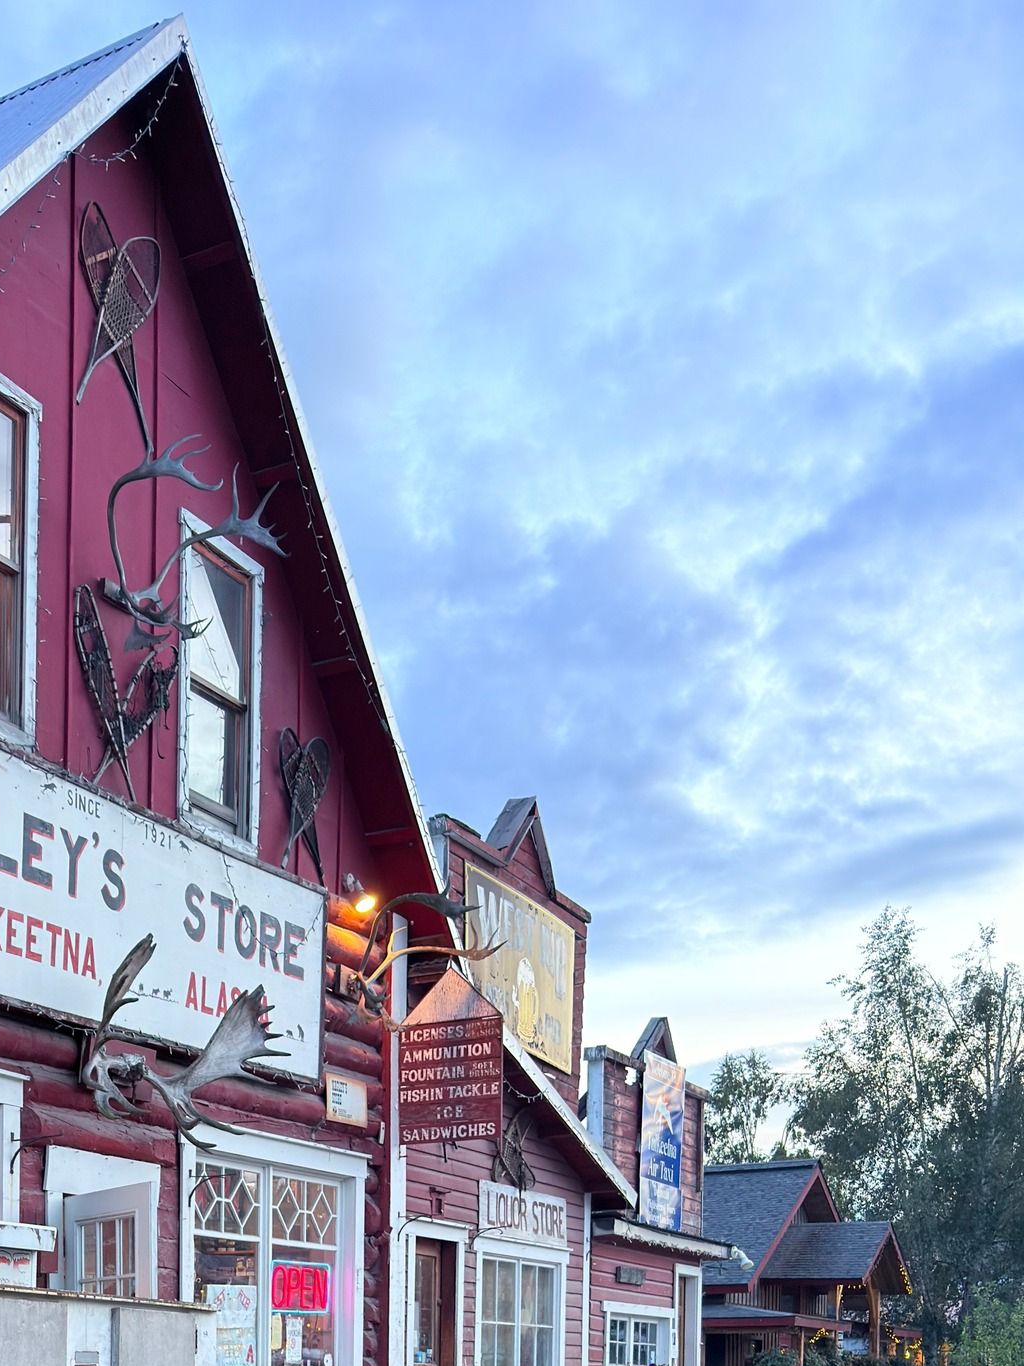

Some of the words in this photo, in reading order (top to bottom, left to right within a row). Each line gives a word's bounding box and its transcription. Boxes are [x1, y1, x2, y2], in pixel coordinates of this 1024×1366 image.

[67, 788, 101, 819] SINCE
[144, 823, 171, 850] 1921
[183, 883, 306, 981] STORE
[401, 1025, 464, 1043] LICENSES
[403, 1042, 492, 1064] AMMUNITION
[401, 1065, 465, 1083] FOUNTAIN
[469, 1068, 501, 1078] DRINKS
[472, 1061, 493, 1070] SOFT
[447, 1082, 500, 1099] TACKLE
[403, 1122, 496, 1142] SANDWICHES
[648, 1157, 659, 1177] Air
[659, 1161, 674, 1183] Taxi
[487, 1190, 528, 1232] LIQUOR
[532, 1200, 565, 1239] STORE
[272, 1265, 328, 1309] OPEN
